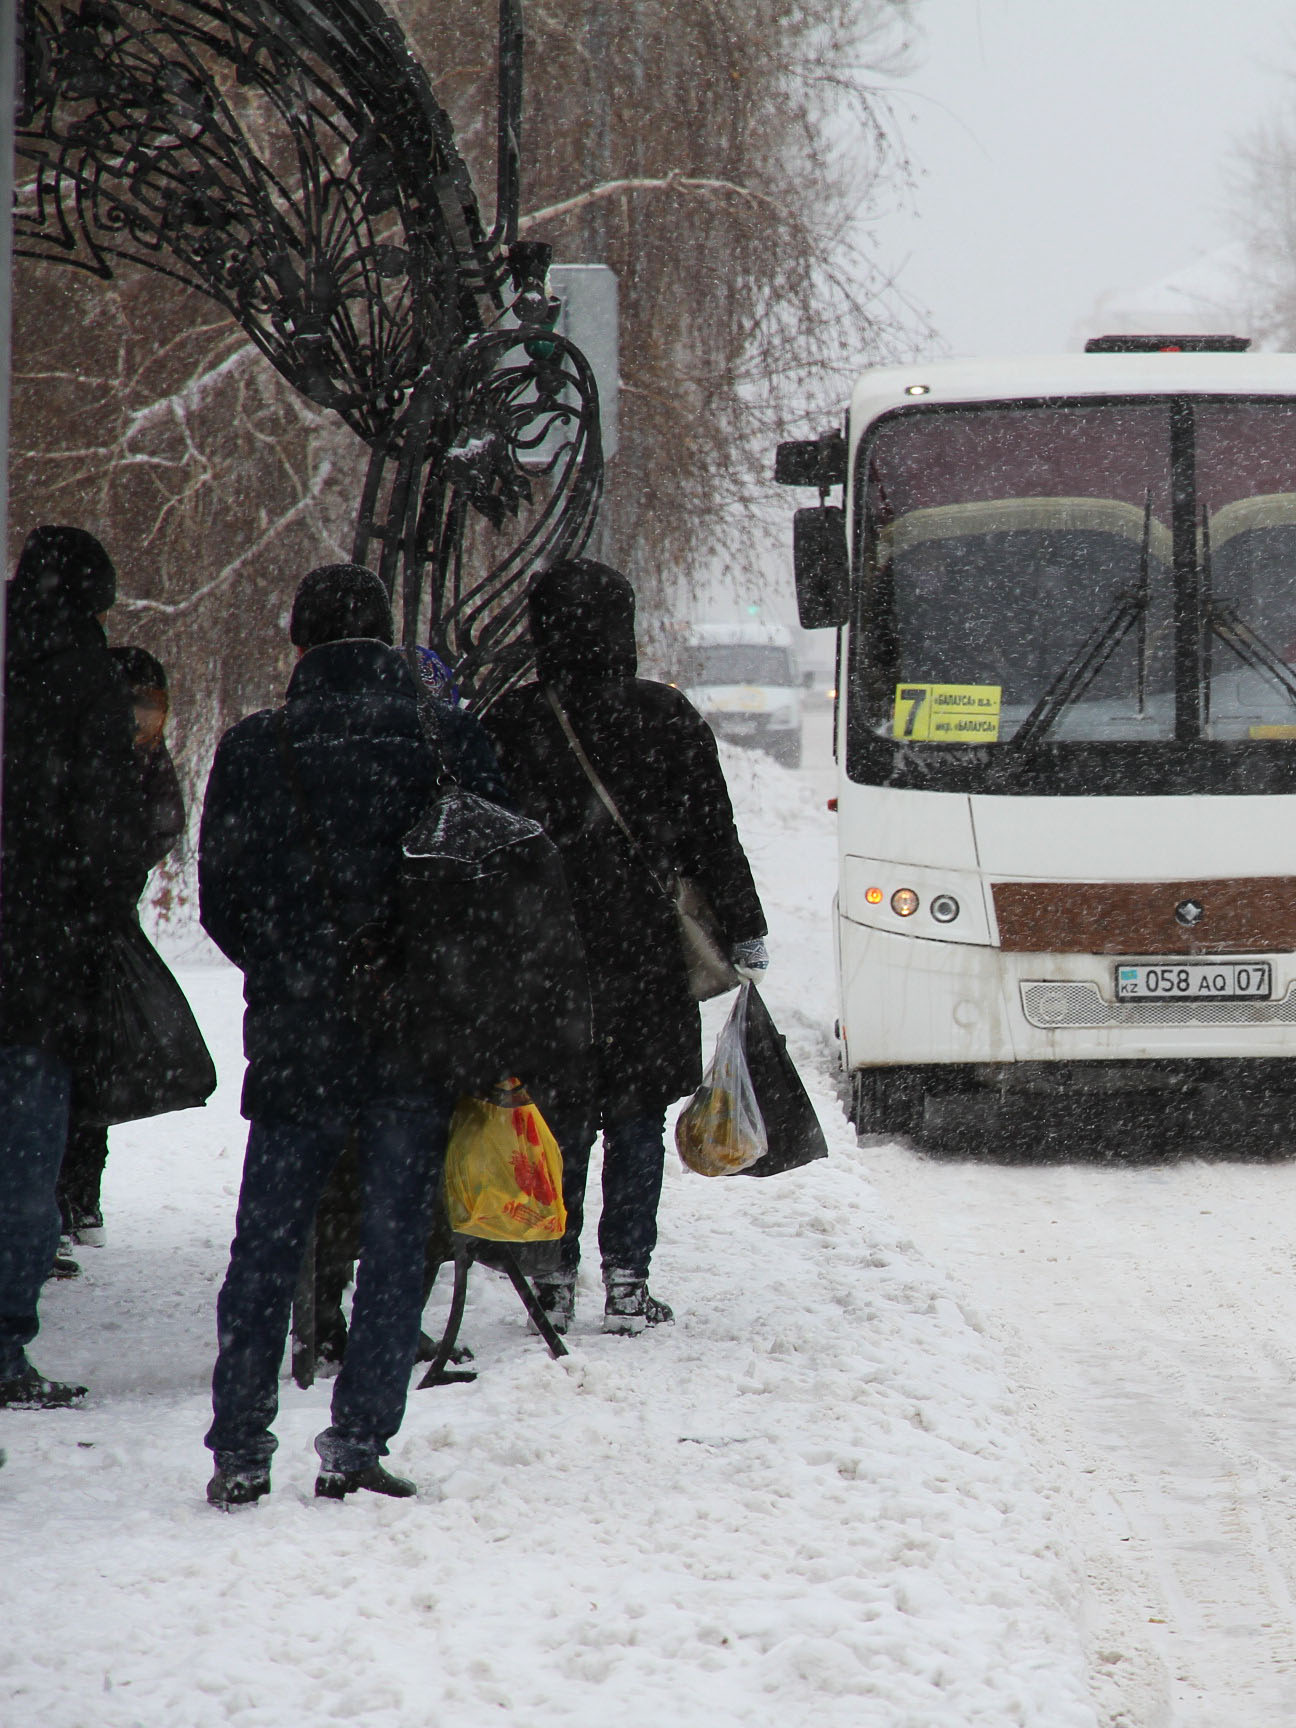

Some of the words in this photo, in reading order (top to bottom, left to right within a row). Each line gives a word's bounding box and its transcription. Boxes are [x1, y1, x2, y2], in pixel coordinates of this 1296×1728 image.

[901, 689, 927, 736] 7
[1121, 983, 1138, 993] KZ
[1146, 969, 1190, 993] 058
[1198, 974, 1227, 992] AQ
[1236, 968, 1266, 992] 07
